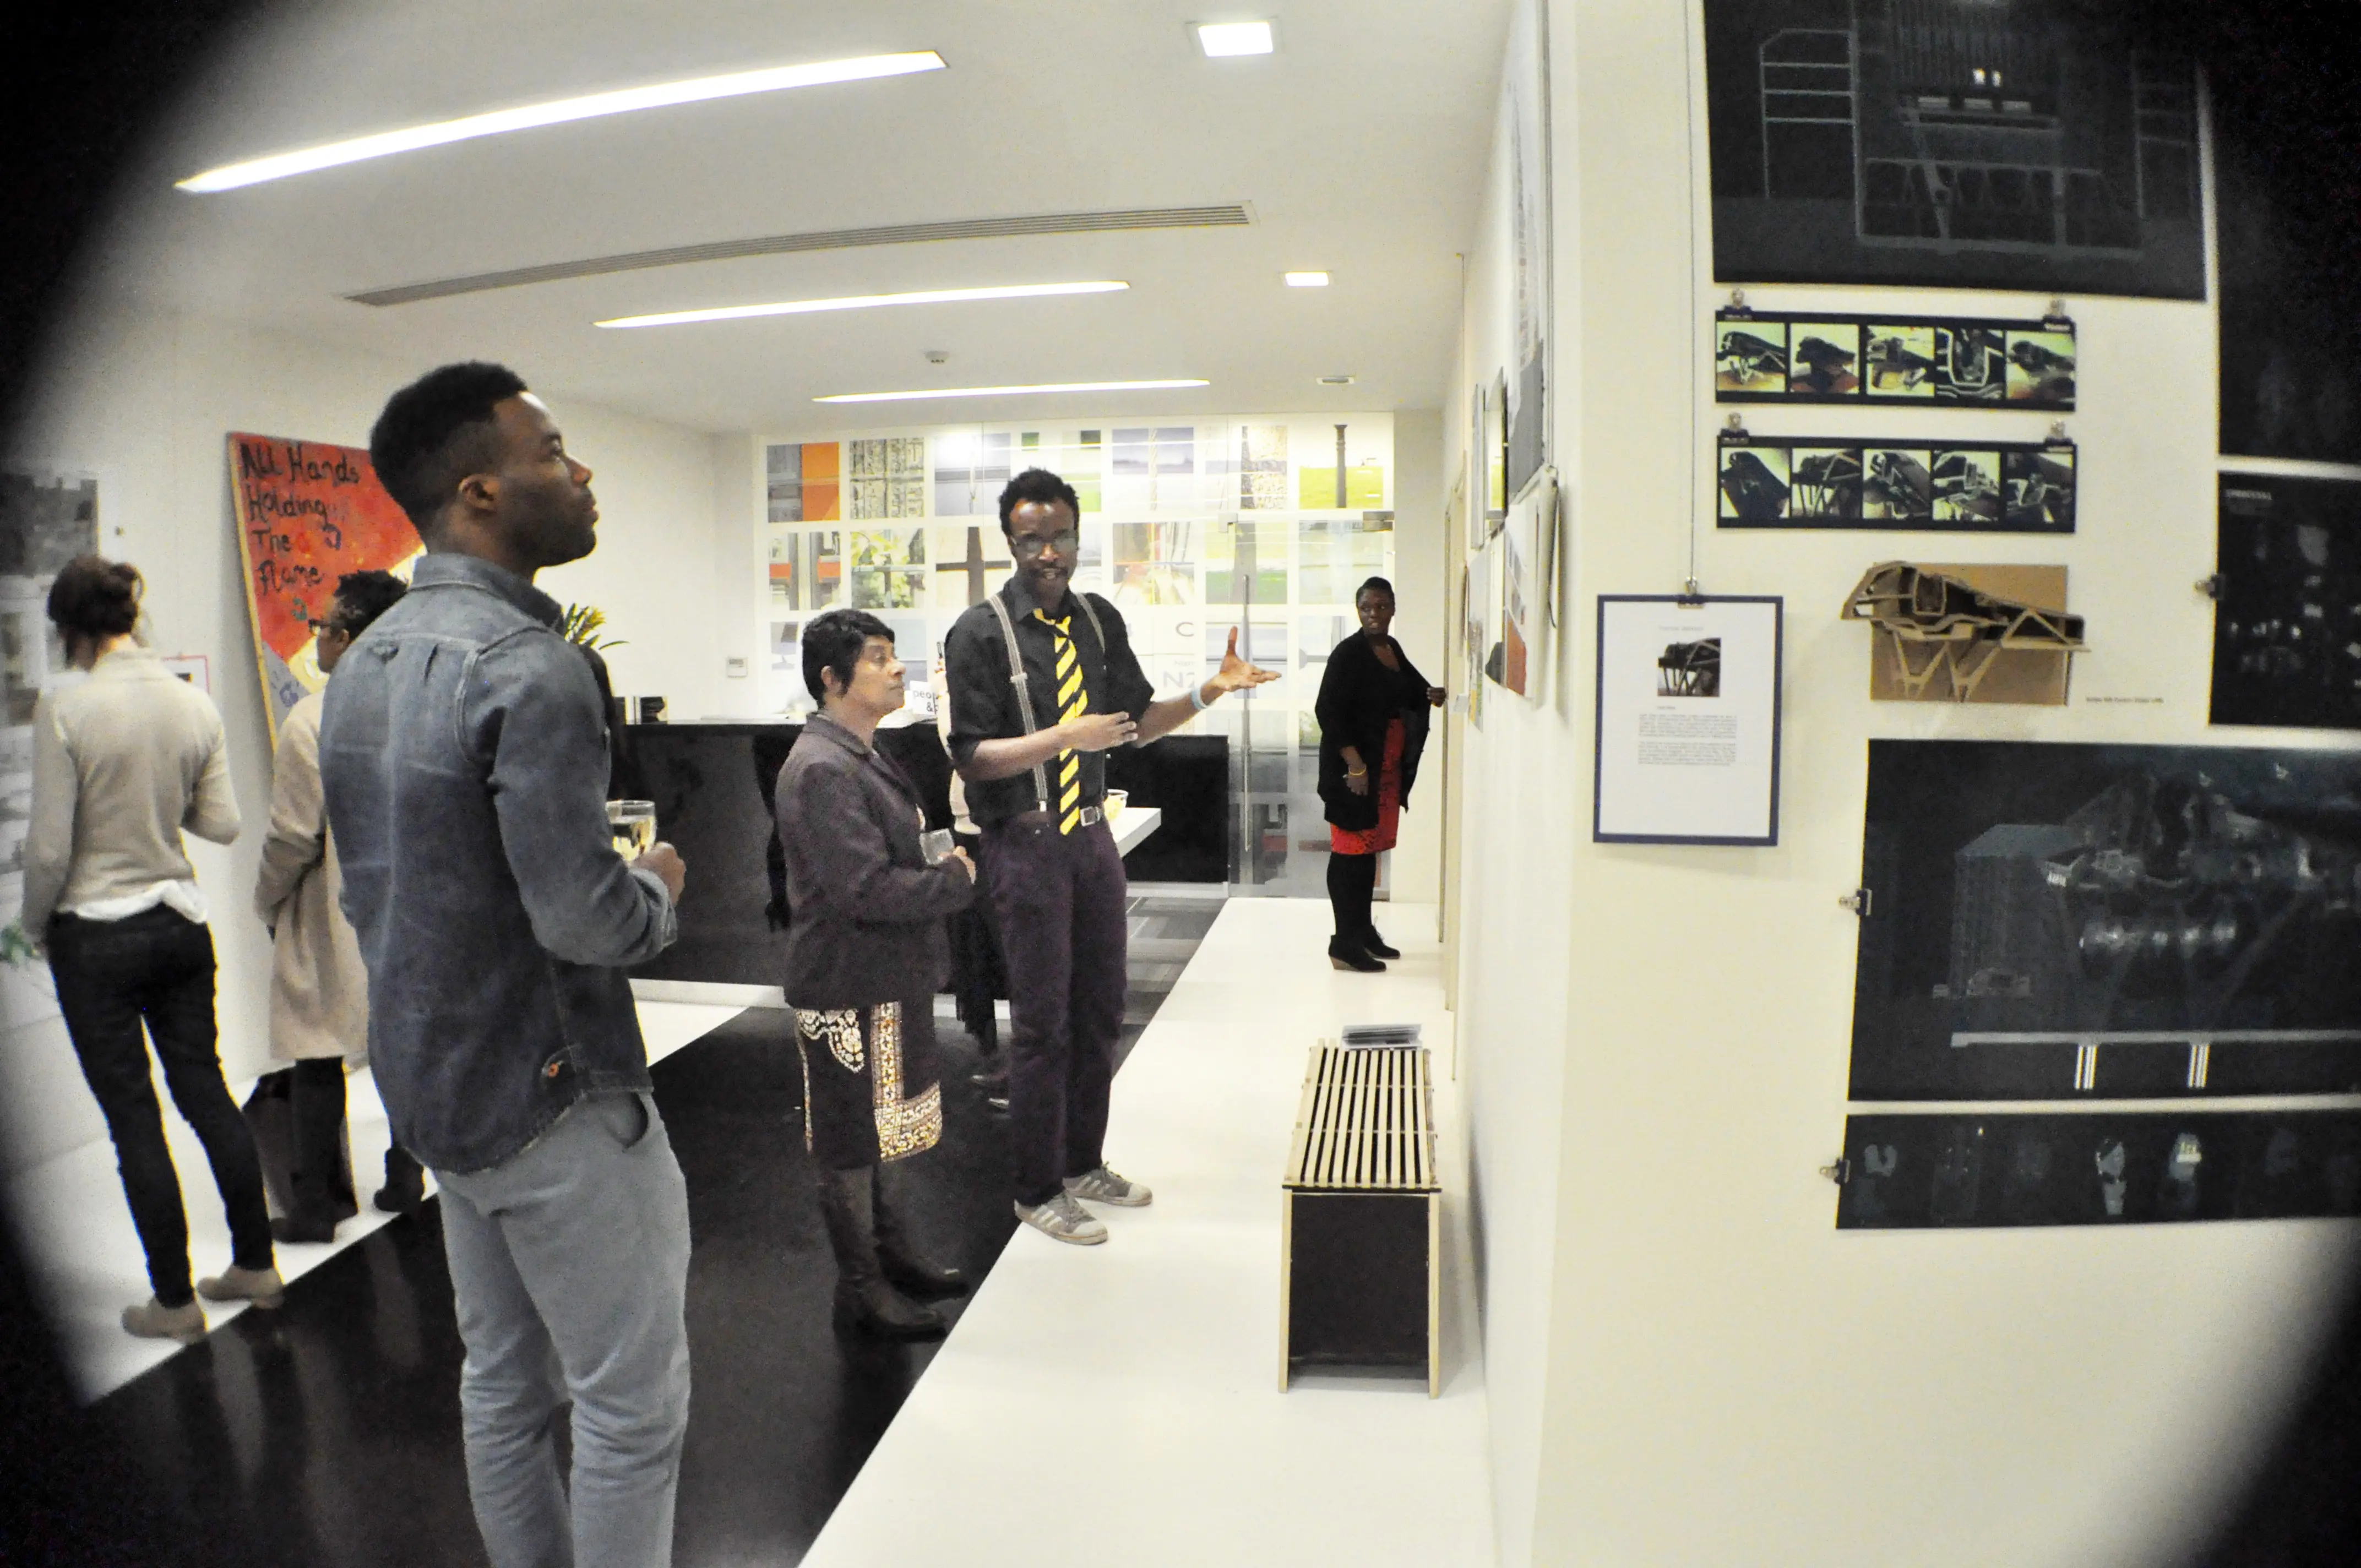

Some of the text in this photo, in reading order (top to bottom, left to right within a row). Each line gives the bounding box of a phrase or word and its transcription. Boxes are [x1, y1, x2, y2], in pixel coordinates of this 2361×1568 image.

[287, 442, 361, 486] Hands
[246, 483, 328, 524] Holding
[252, 526, 291, 553] The
